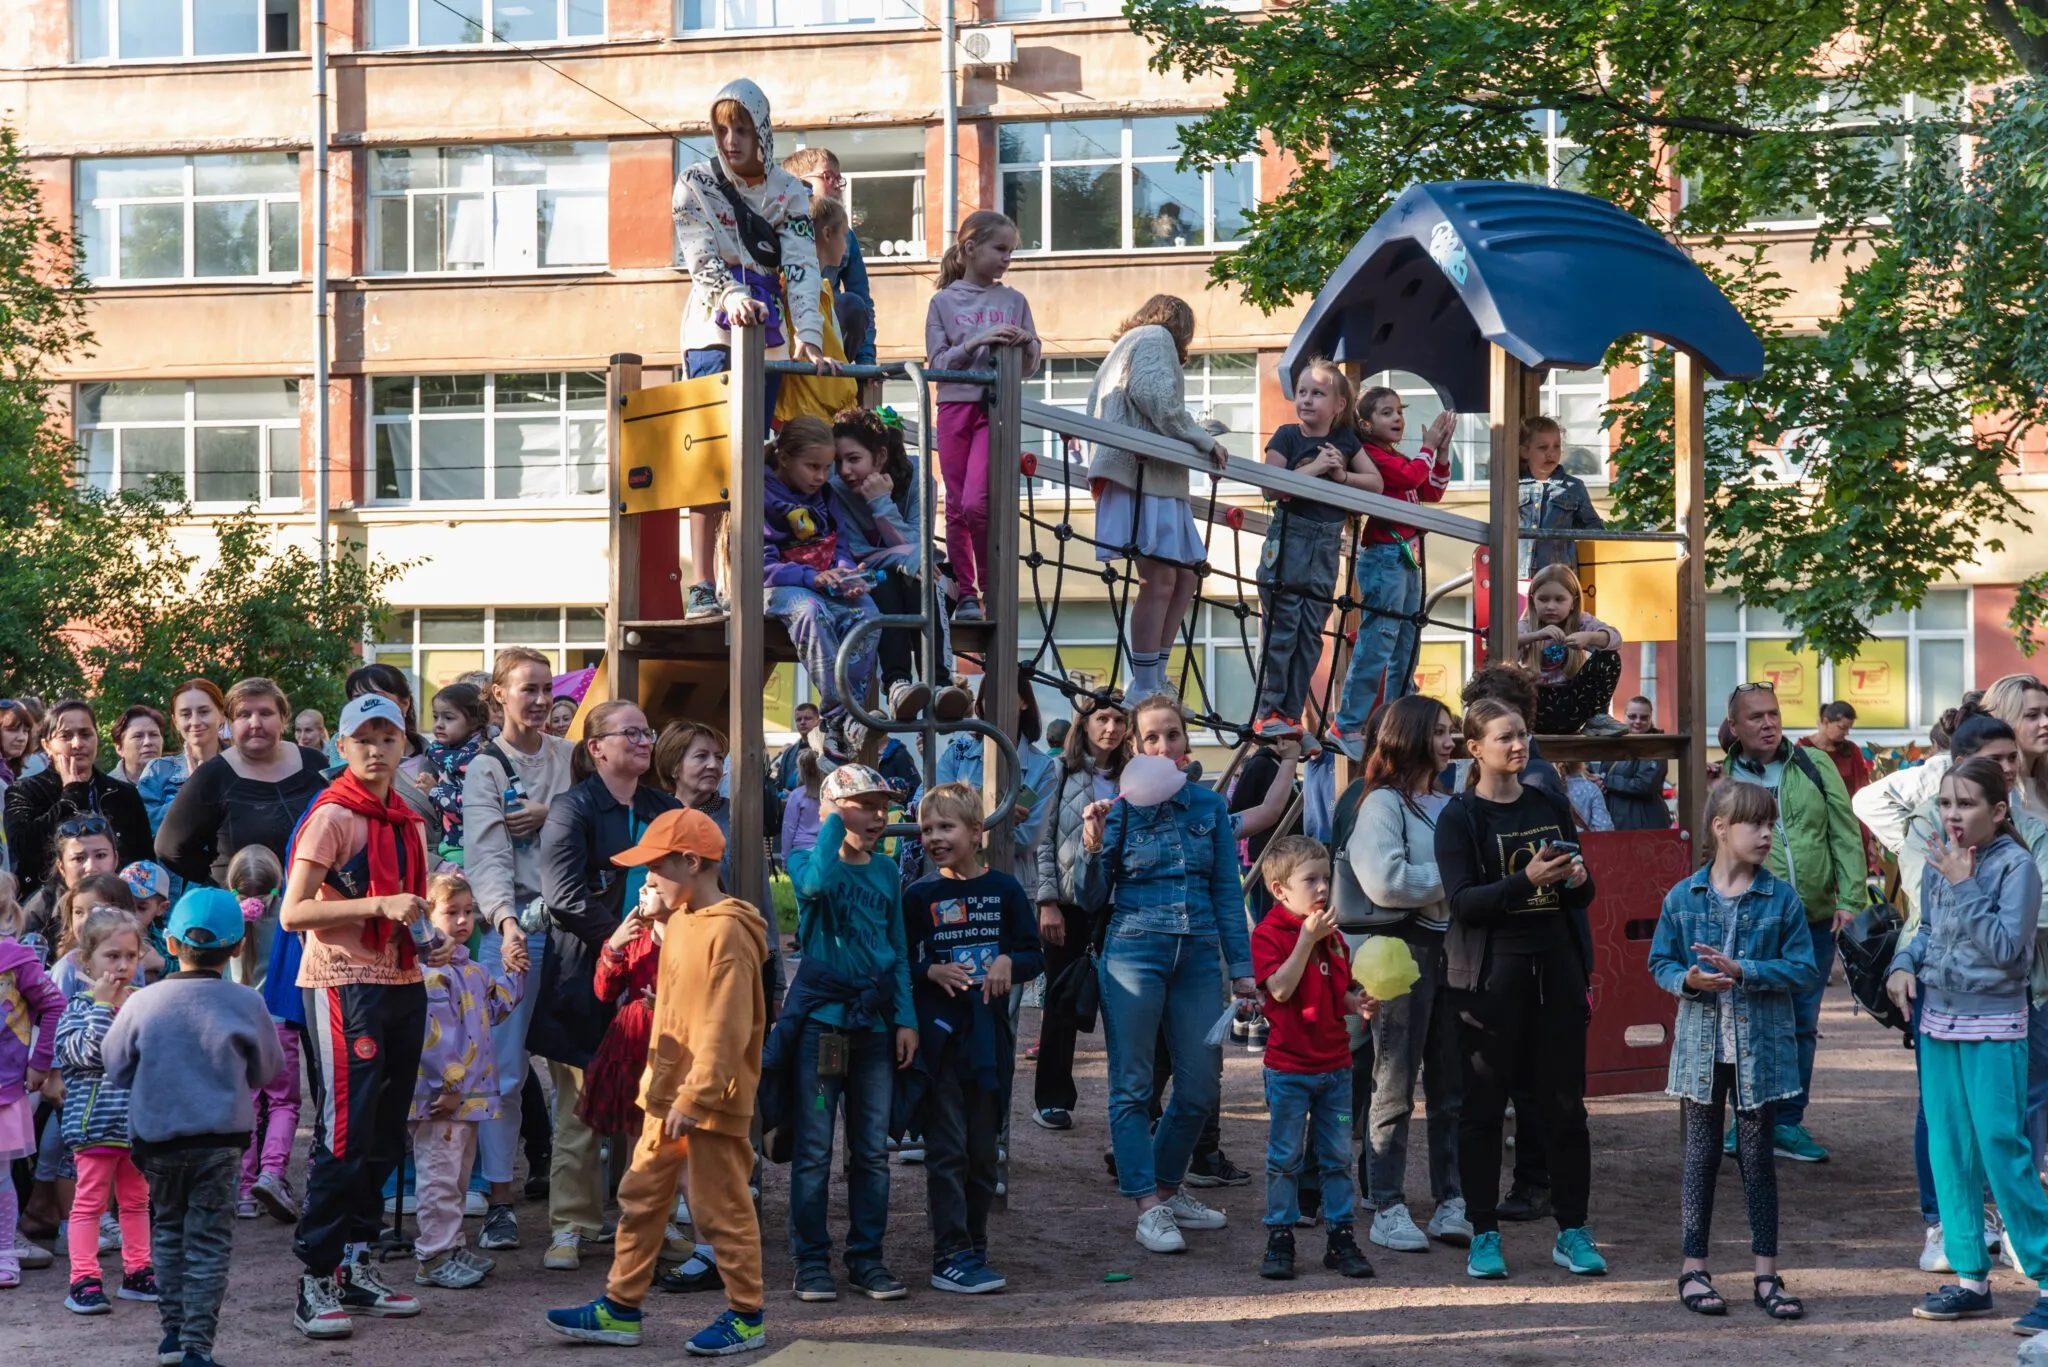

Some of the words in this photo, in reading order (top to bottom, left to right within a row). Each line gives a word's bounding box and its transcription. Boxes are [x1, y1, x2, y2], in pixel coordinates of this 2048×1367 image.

[968, 912, 1001, 921] PINES
[964, 928, 978, 937] NO
[980, 927, 1000, 936] ONE
